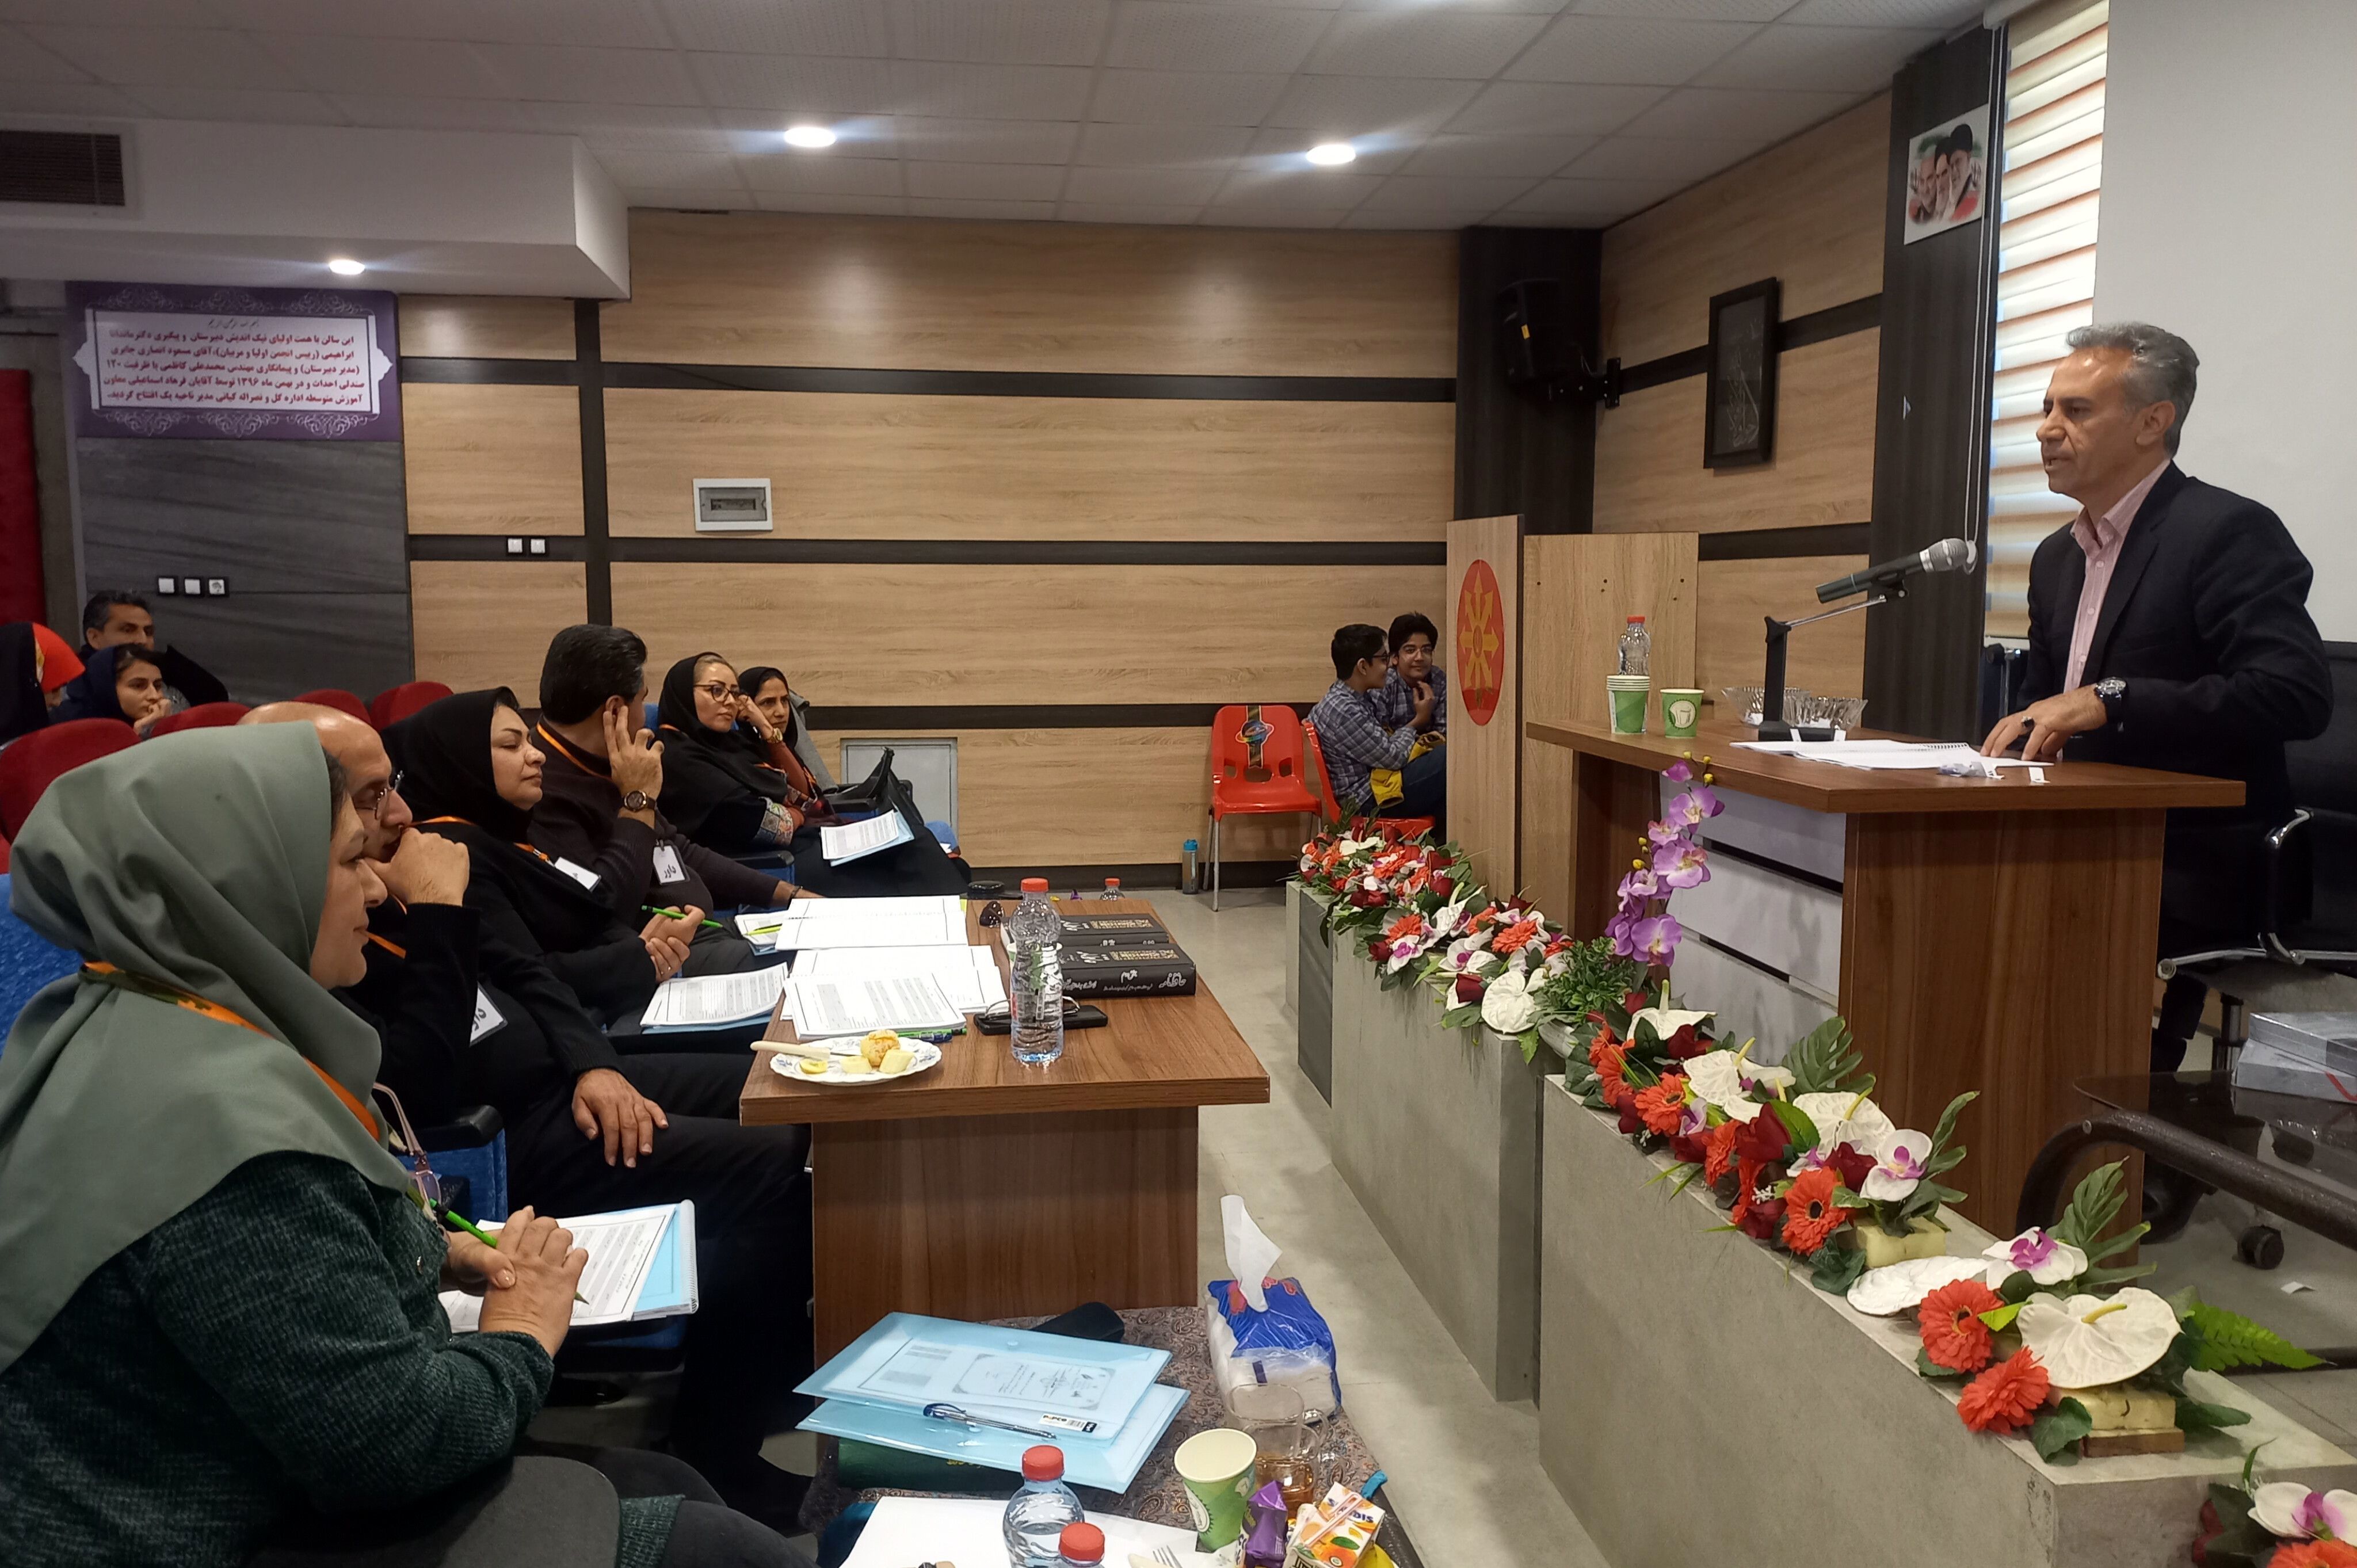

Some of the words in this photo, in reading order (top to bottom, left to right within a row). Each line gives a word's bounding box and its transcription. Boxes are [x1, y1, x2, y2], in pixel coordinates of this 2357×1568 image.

[135, 331, 152, 341] دکتر
[154, 331, 180, 341] پیگیری
[190, 331, 223, 342] دبیرستان
[252, 334, 267, 343] نیک
[269, 334, 293, 344] اولیای
[294, 334, 312, 343] همت
[314, 335, 320, 343] با
[322, 335, 340, 345] سالن
[342, 336, 354, 345] این
[138, 346, 166, 355] انصاری
[168, 347, 191, 357] مسعود
[193, 346, 212, 357] آقای
[252, 348, 268, 359] اولیا
[270, 350, 293, 359] انجمن
[322, 351, 354, 360] ابراهیمی
[124, 360, 150, 371] ظرفیت
[152, 361, 158, 371] با
[160, 361, 186, 371] کاظمی
[227, 364, 254, 373] مهندس
[256, 364, 292, 375] پیمانکاری
[300, 364, 337, 375] دبیرستان)
[338, 365, 360, 375] (مدیر
[128, 376, 163, 386] اسماعیلی
[165, 376, 186, 387] فرهاد
[189, 376, 212, 387] آقایان
[215, 377, 235, 387] توسط
[275, 380, 293, 388] بهمن
[295, 381, 304, 390] در
[312, 380, 337, 388] احداث
[339, 380, 365, 390] صندلی
[136, 391, 158, 401] افتتاح
[160, 391, 172, 401] یک
[175, 392, 194, 400] ناحیه
[197, 393, 214, 402] مدیر
[271, 393, 283, 403] کل
[284, 394, 304, 404] اداره
[305, 394, 333, 403] متوسطه
[335, 394, 363, 405] آموزش
[664, 864, 677, 879] داور
